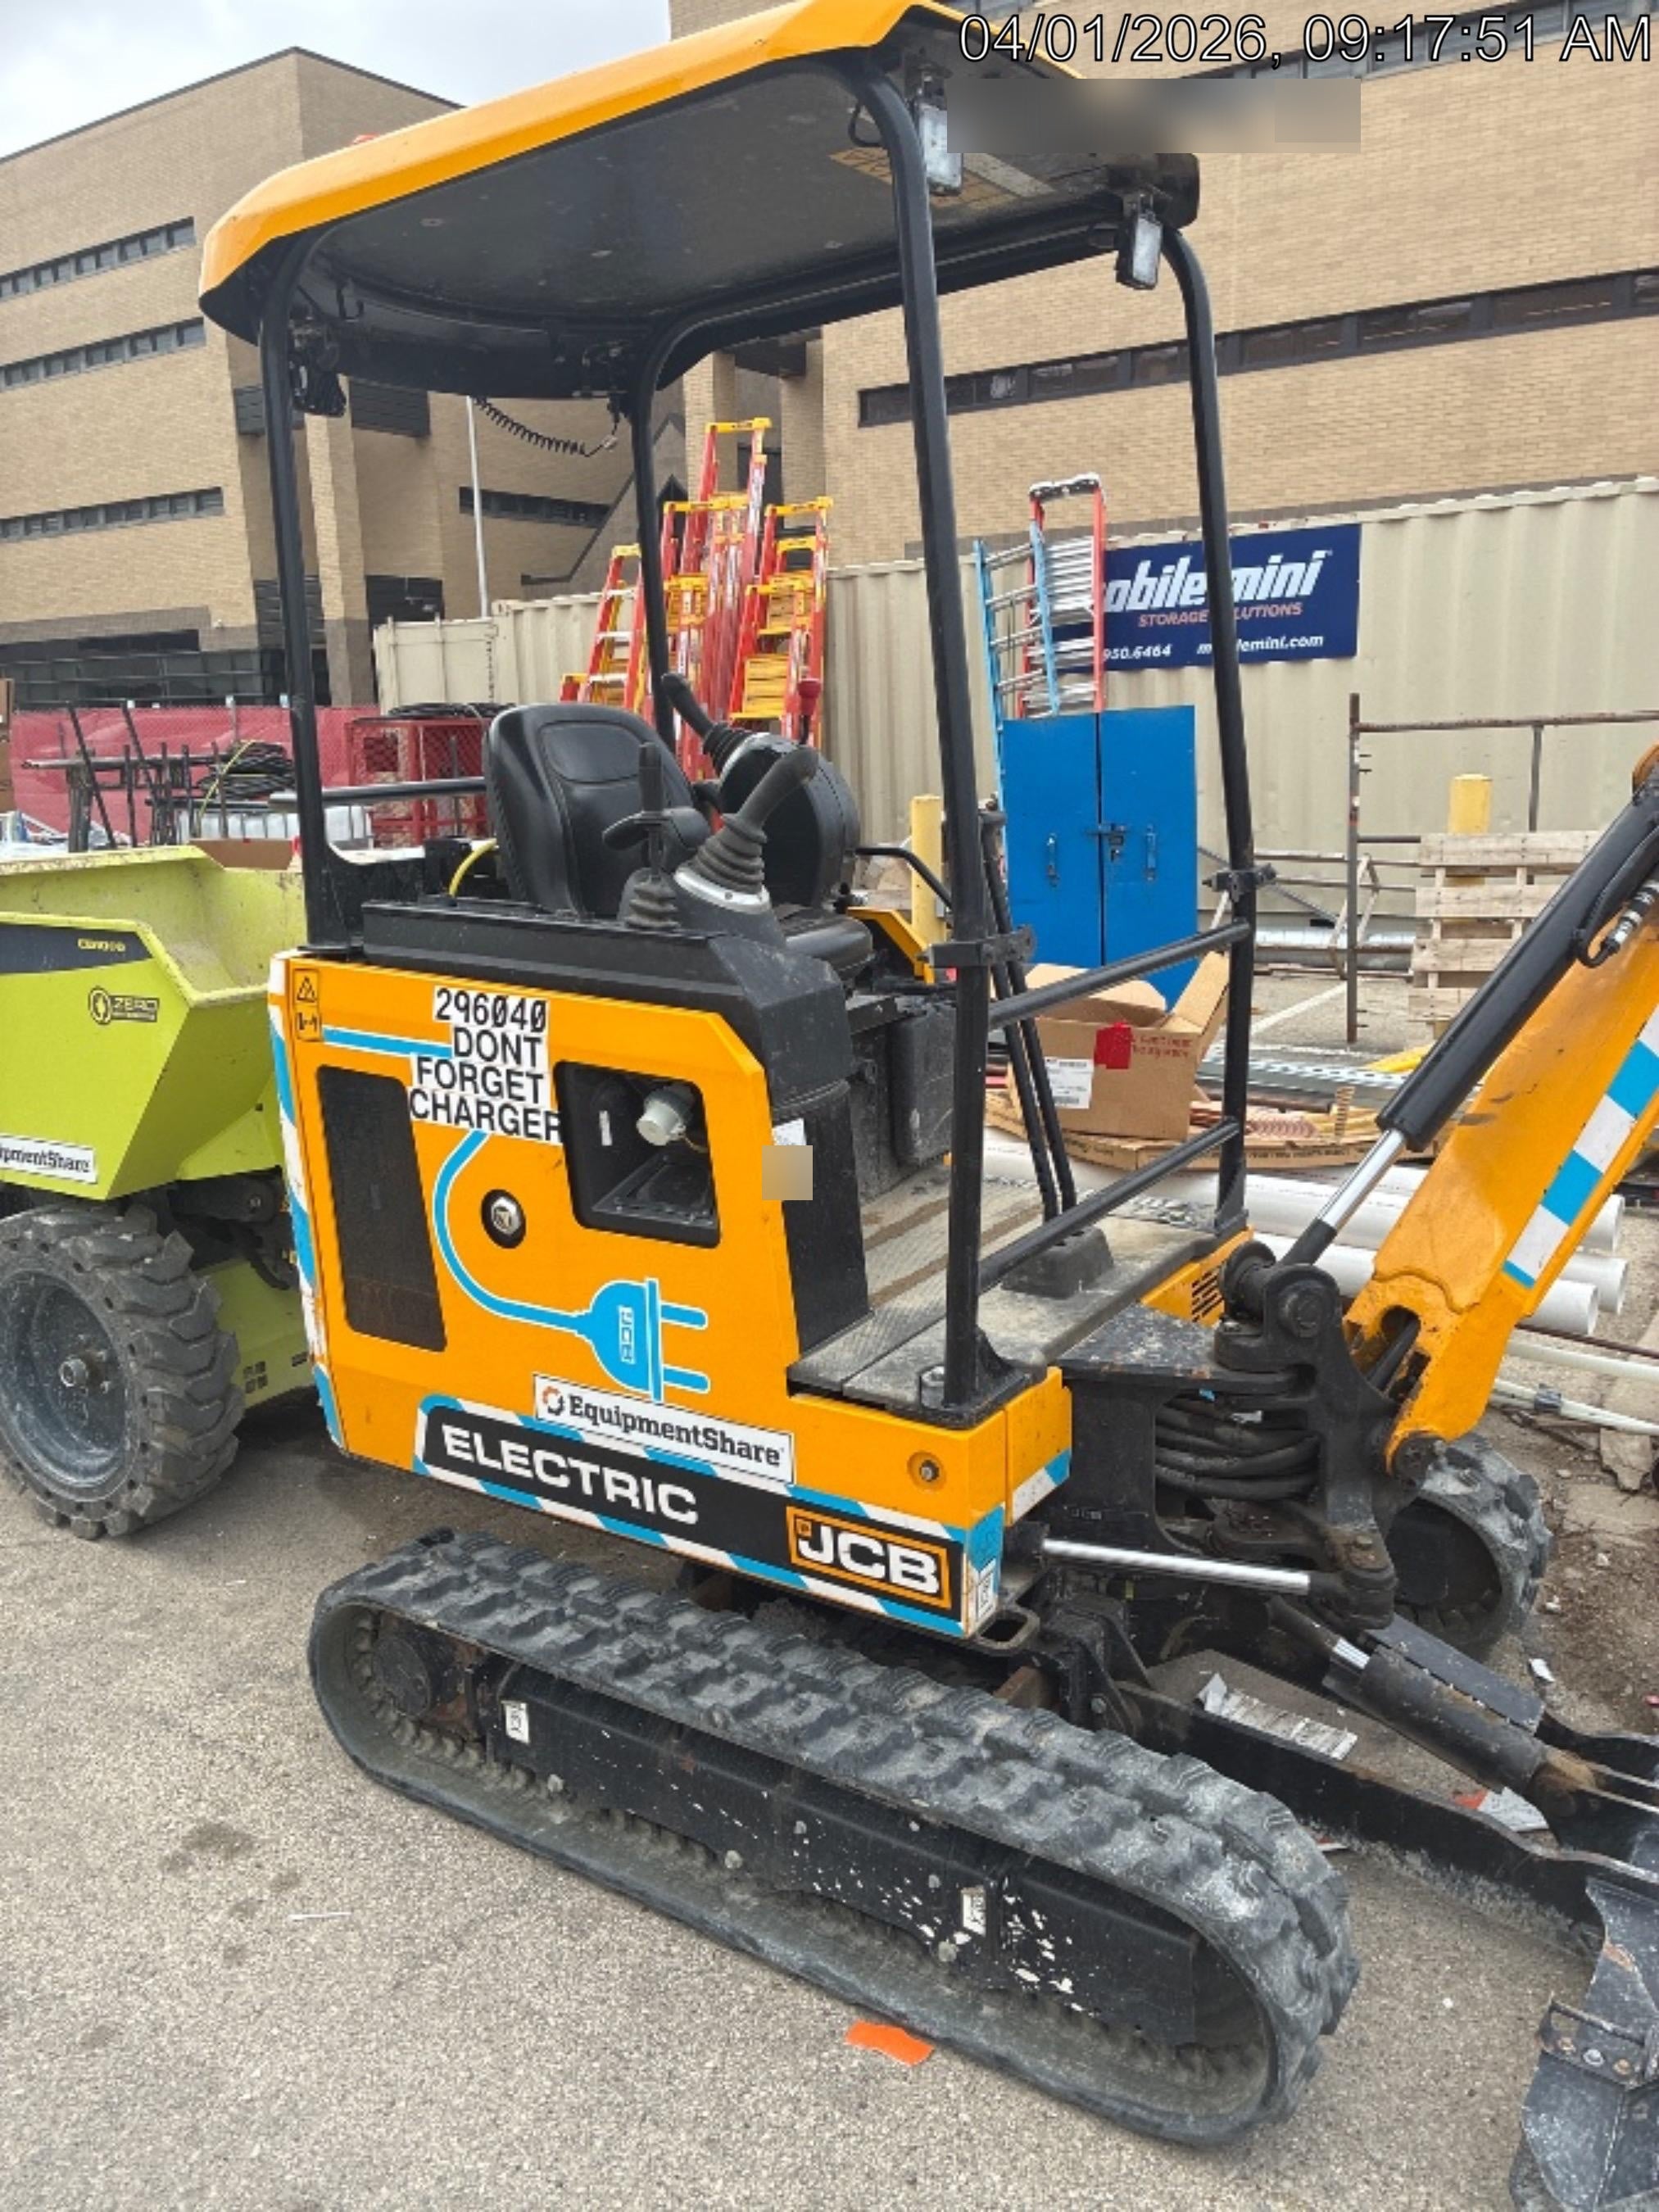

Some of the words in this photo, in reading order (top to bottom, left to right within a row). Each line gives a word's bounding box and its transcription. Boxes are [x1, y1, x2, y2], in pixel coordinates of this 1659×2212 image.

[1104, 555, 1209, 613] obile
[1138, 609, 1210, 628] STORAGE
[1233, 601, 1303, 620] LUTIONS
[453, 1027, 542, 1067] DONT
[416, 1055, 544, 1104] FORGET
[410, 1088, 560, 1141] CHARGER
[568, 1394, 781, 1466] EquipmentShare
[442, 1423, 699, 1525] ELECTRIC
[798, 1524, 940, 1594] JCB
